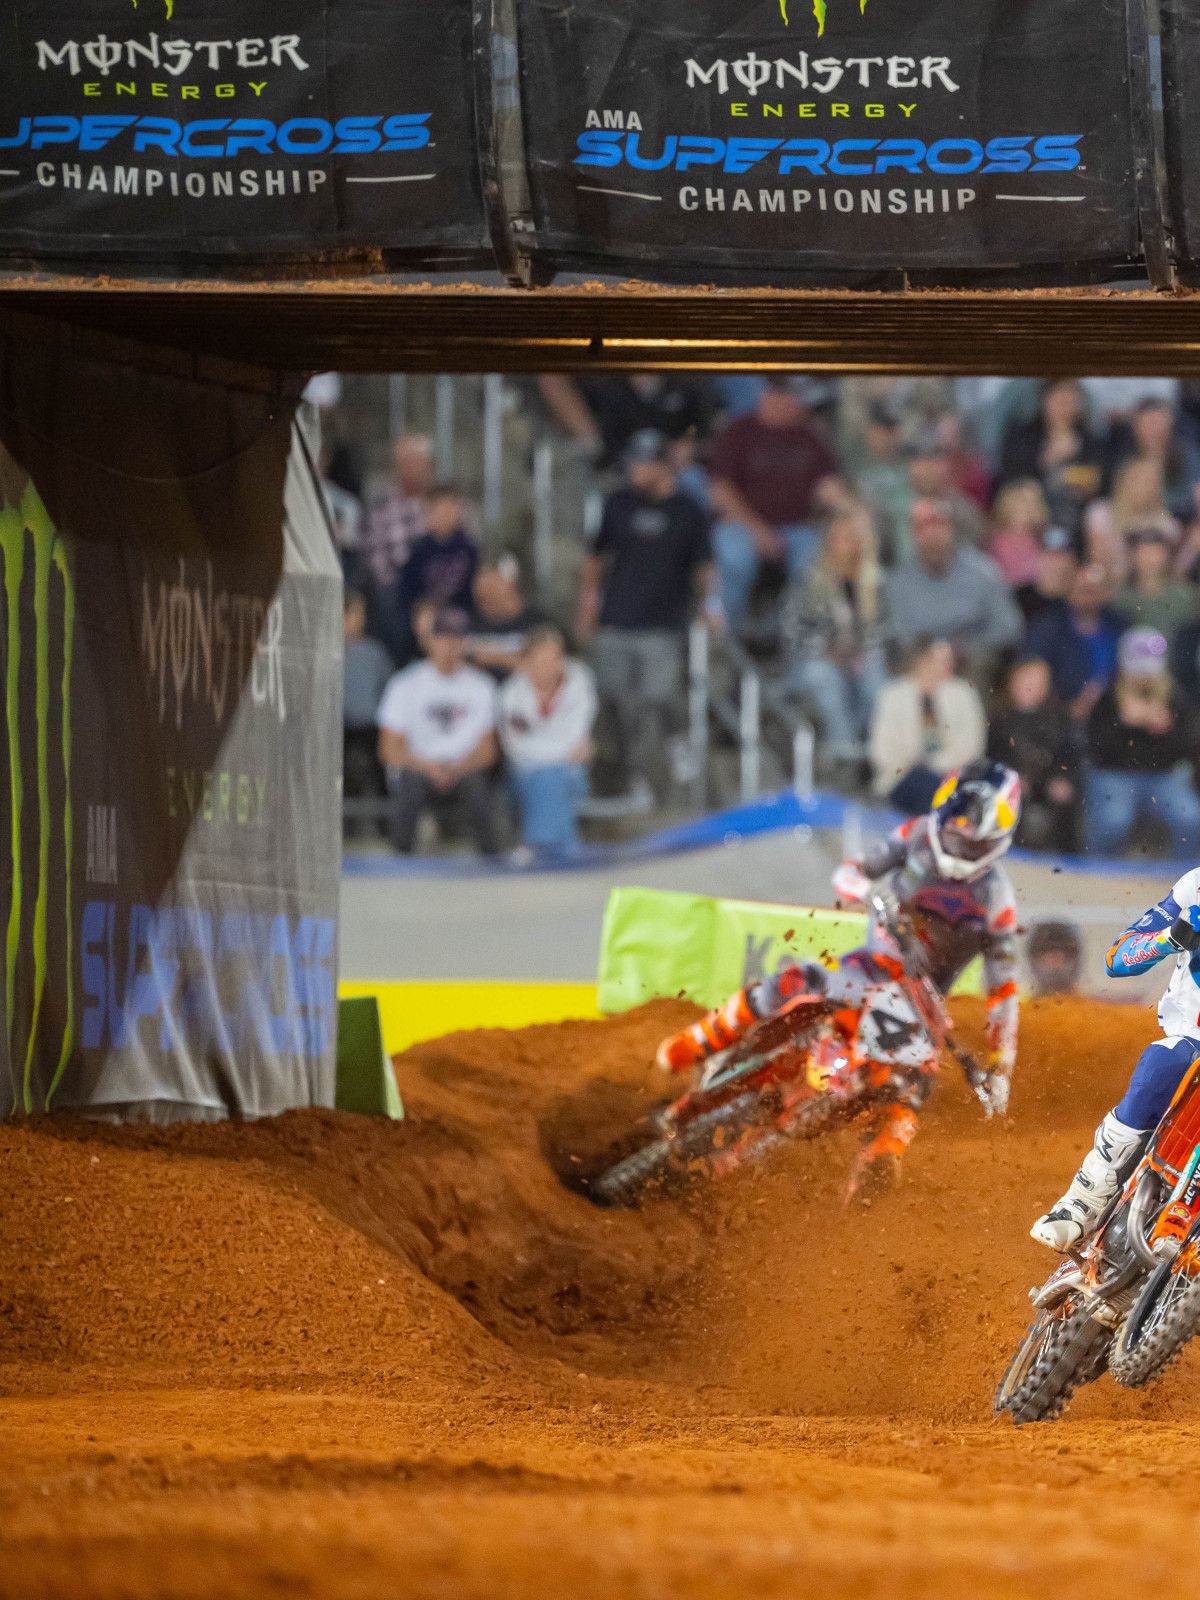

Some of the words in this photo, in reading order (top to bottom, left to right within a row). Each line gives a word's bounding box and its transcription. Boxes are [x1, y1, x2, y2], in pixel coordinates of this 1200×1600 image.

[36, 32, 309, 75] MONSTER
[684, 50, 960, 96] MONSTER
[83, 81, 267, 99] ENERGY
[585, 109, 643, 131] AMA
[730, 102, 917, 118] ENERGY
[0, 112, 433, 157] UPERCROSS
[572, 131, 1085, 176] SUPERCROSS
[36, 161, 327, 198] CHAMPIONSHIP
[678, 185, 977, 215] CHAMPIONSHIP
[140, 556, 288, 730] MONSTER
[1122, 950, 1141, 966] Red
[1140, 945, 1160, 962] Bull
[870, 1009, 919, 1050] 4
